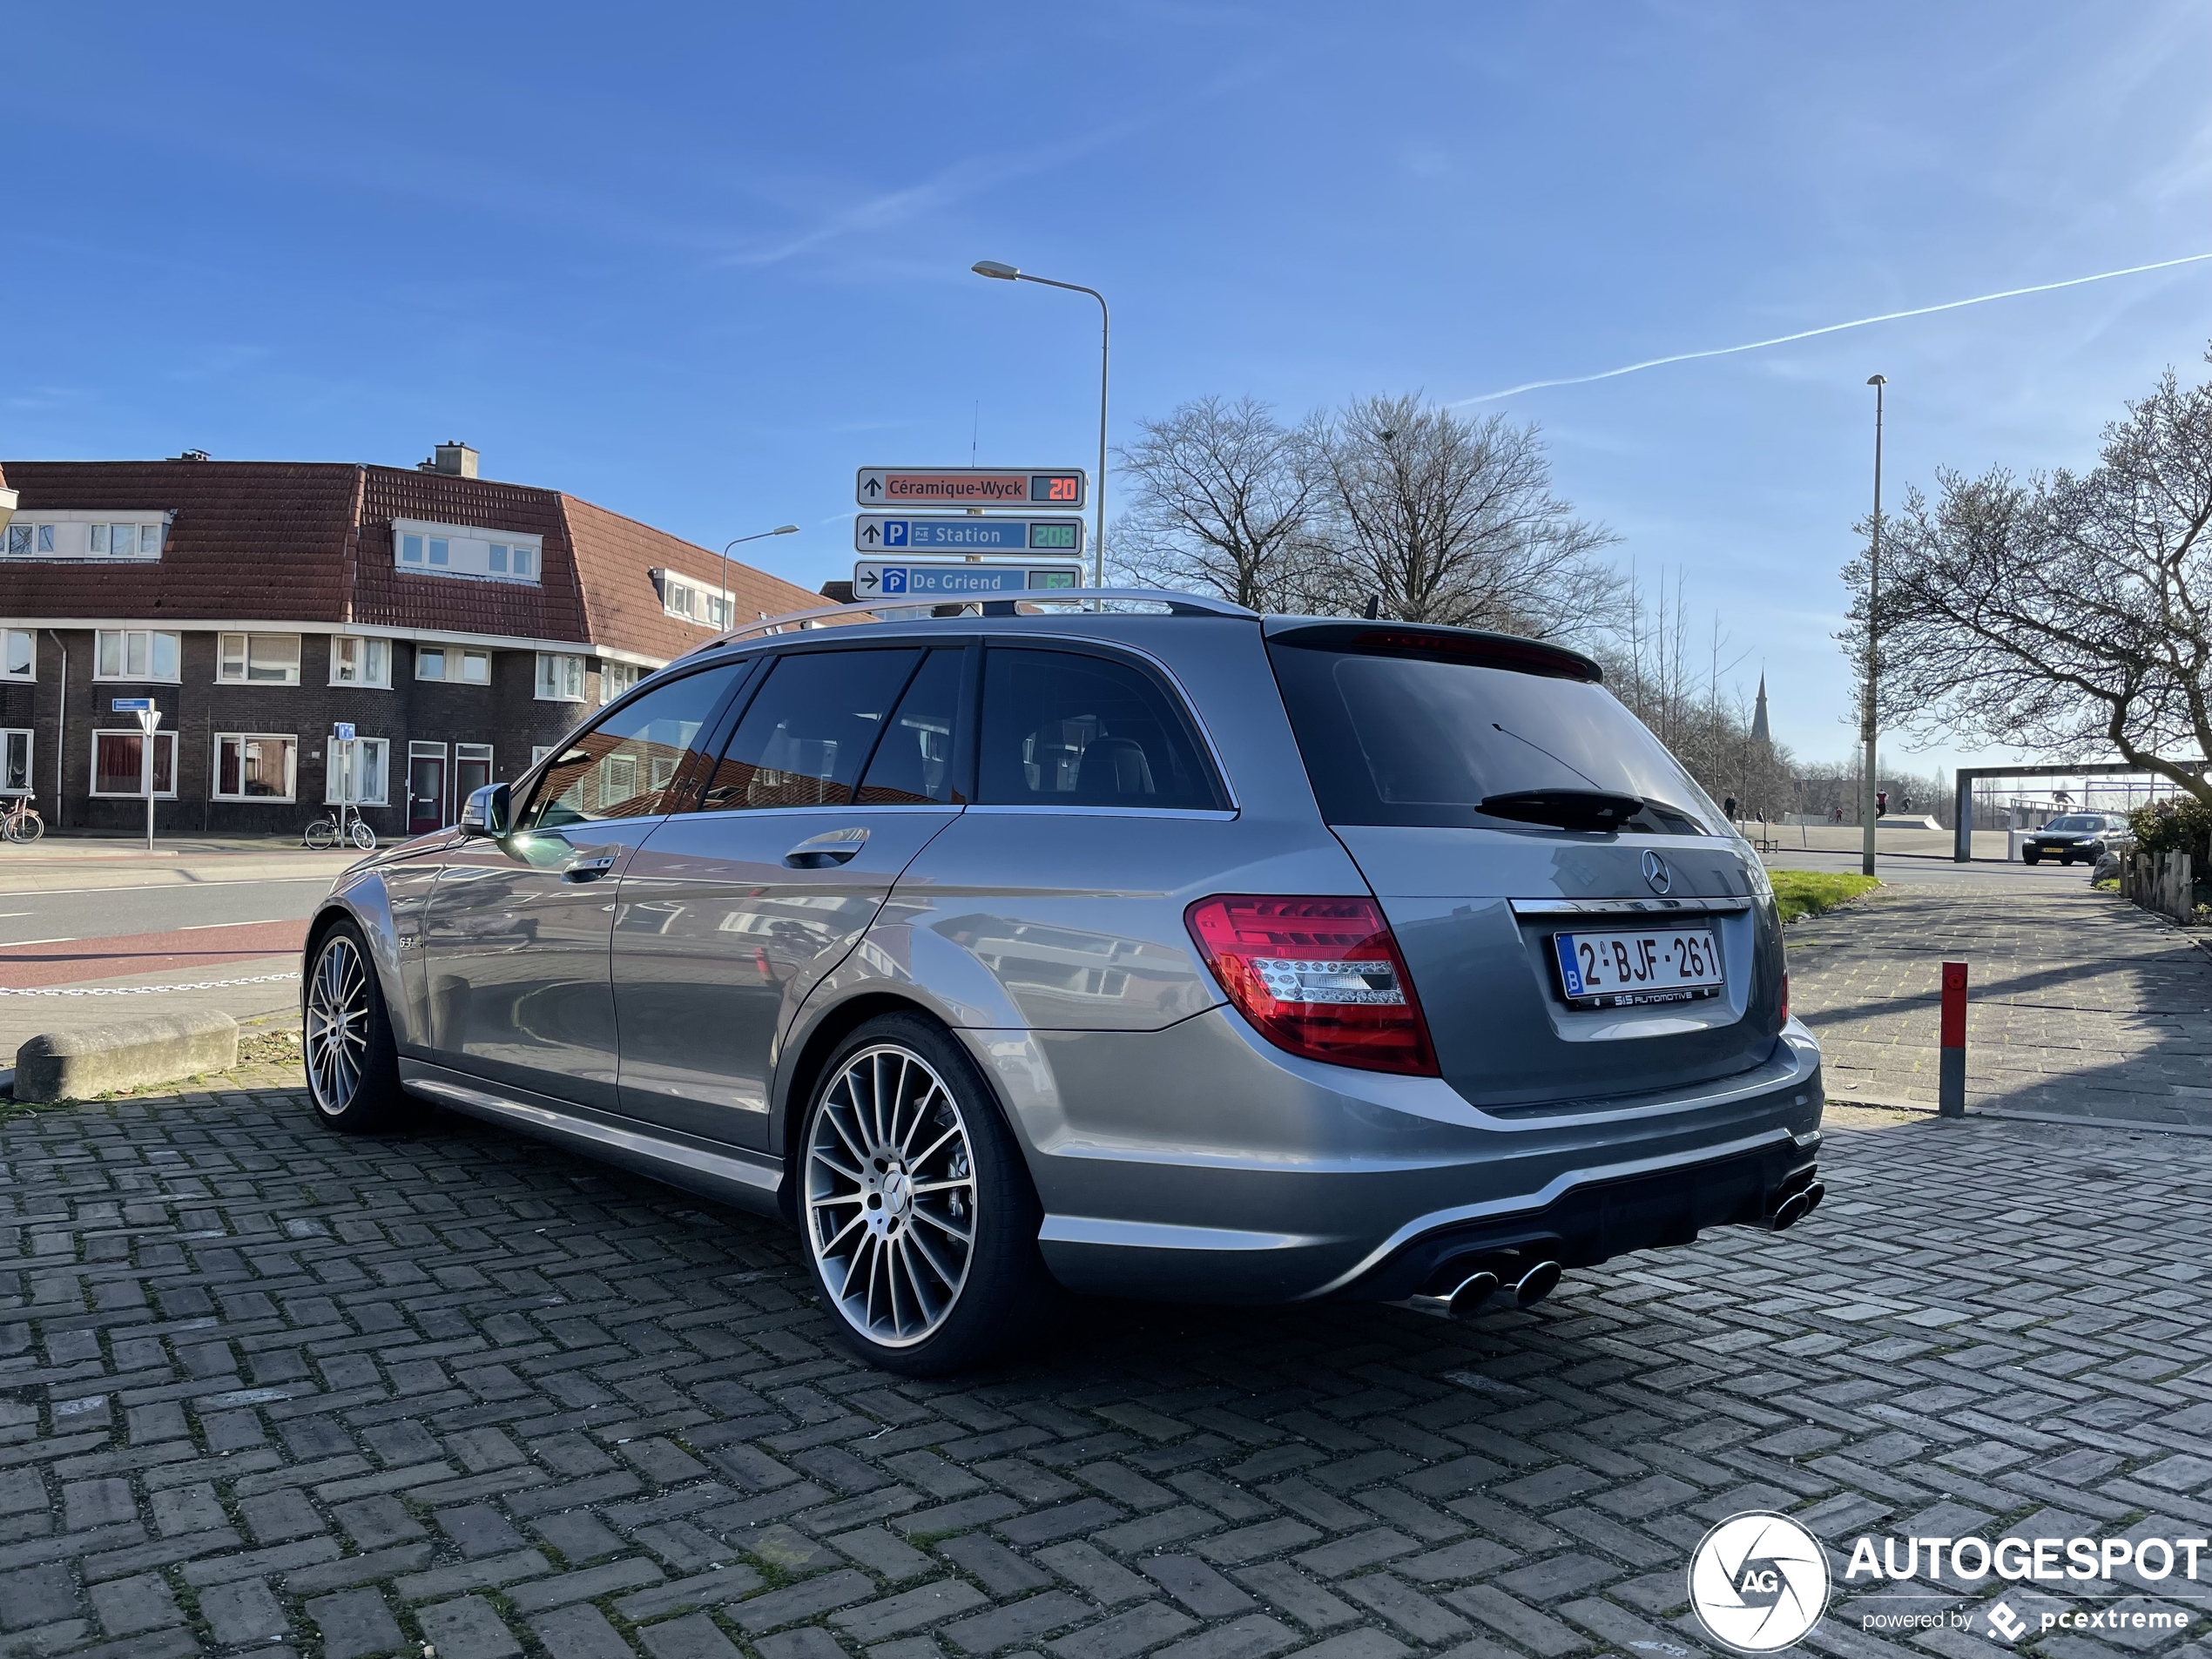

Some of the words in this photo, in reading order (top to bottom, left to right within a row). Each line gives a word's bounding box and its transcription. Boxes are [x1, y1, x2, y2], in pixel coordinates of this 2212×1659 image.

[889, 480, 1022, 499] Céramique-Wyck
[1049, 479, 1076, 500] 20
[890, 524, 904, 543] P
[935, 528, 1001, 543] Station
[1035, 527, 1075, 547] 208
[914, 575, 936, 589] De
[942, 575, 1001, 590] Griend
[1568, 970, 1580, 990] B
[1635, 991, 1693, 1004] AUTOMOTIVE
